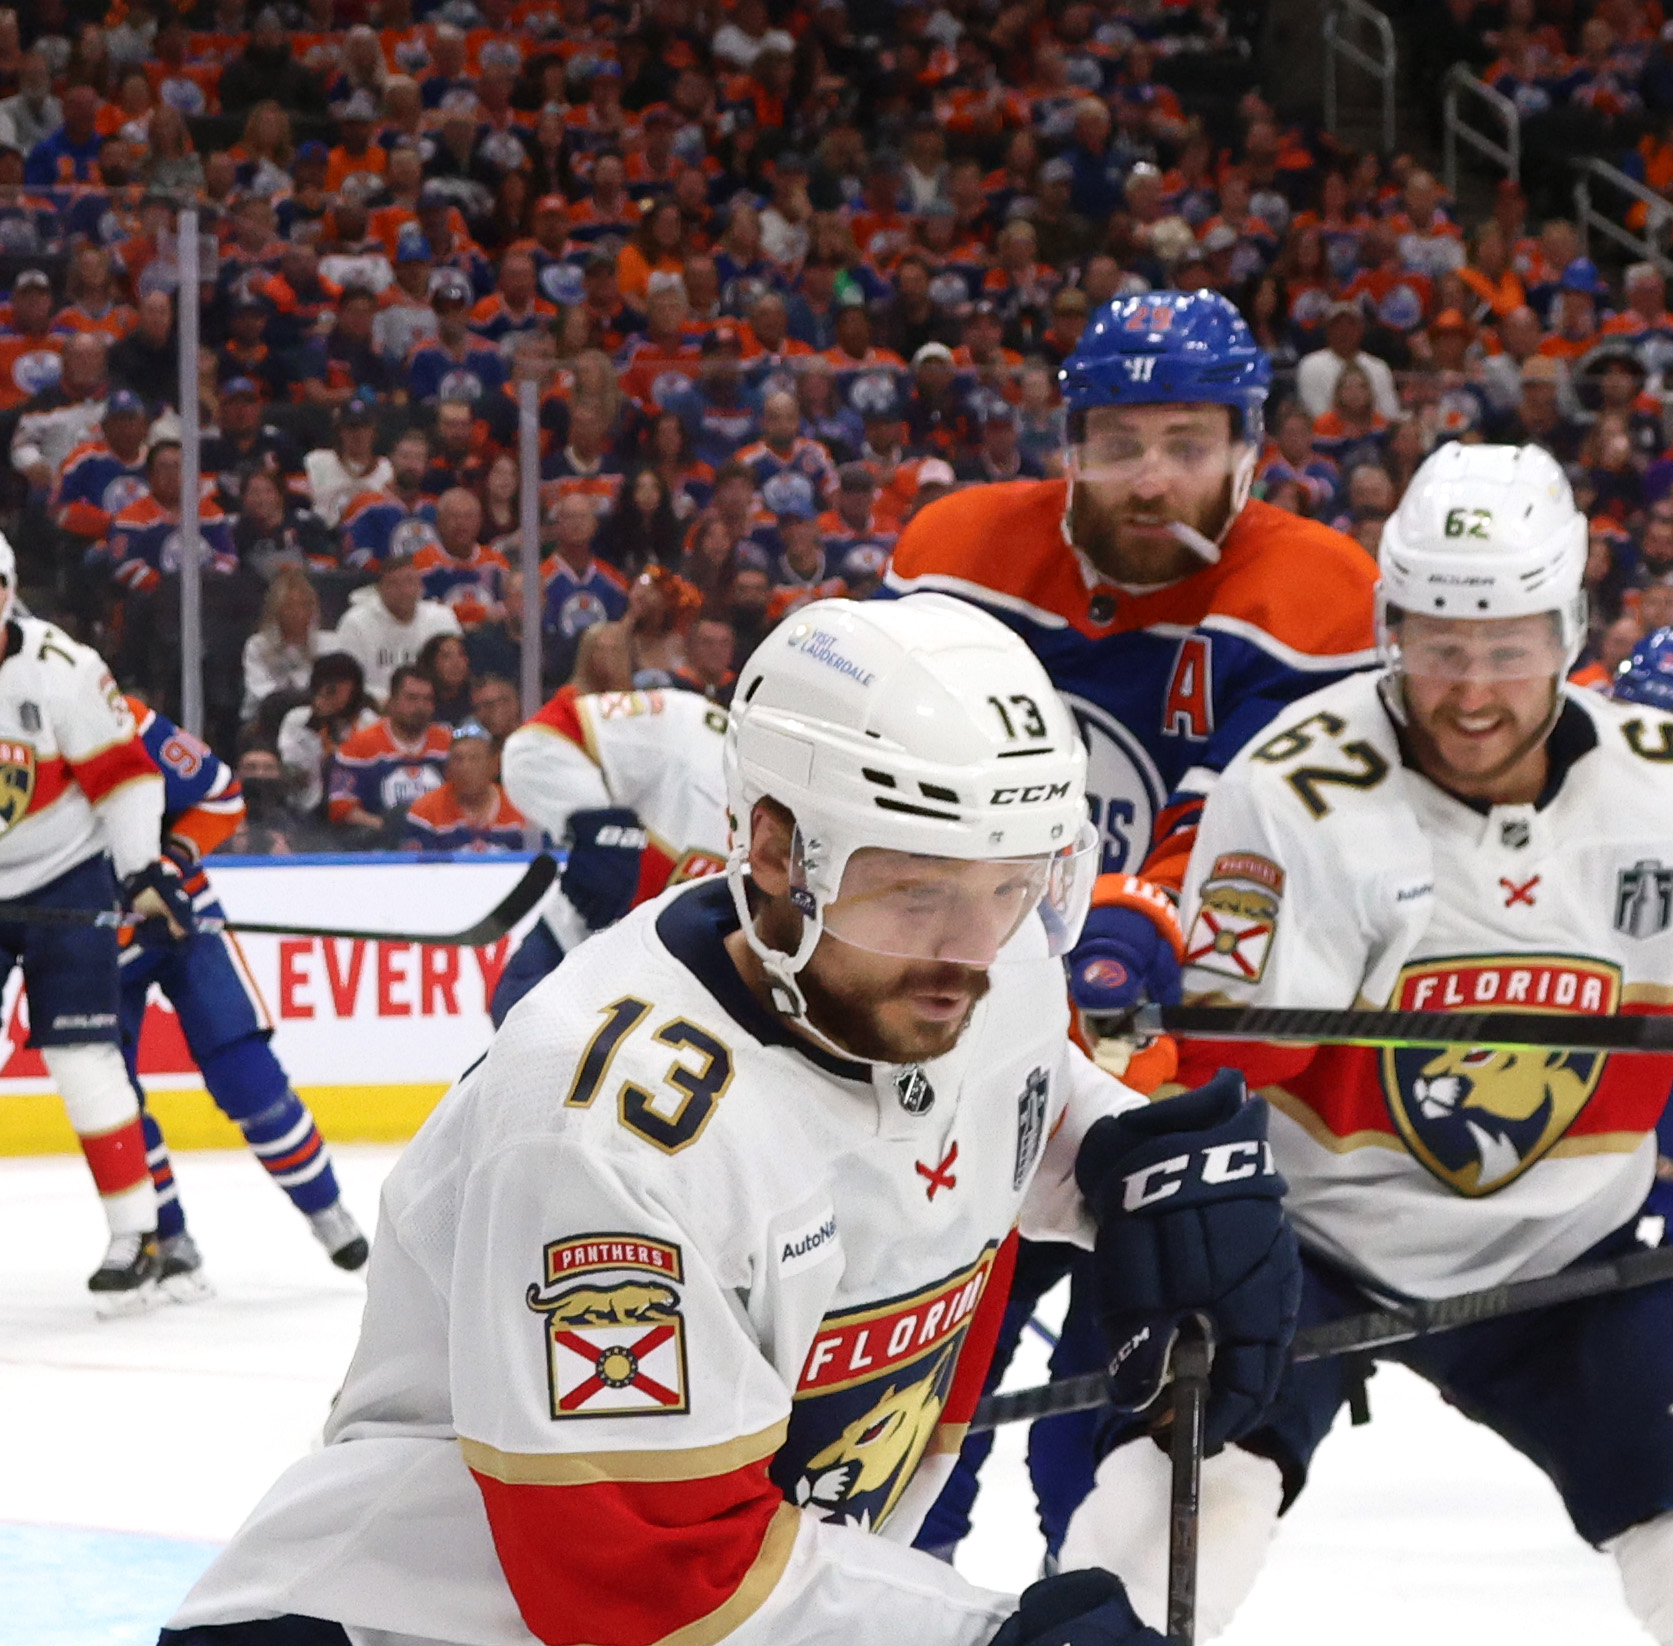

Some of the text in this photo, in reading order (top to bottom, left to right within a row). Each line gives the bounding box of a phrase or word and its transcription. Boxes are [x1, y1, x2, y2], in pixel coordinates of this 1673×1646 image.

[1126, 307, 1172, 330] 29
[1445, 508, 1491, 538] 62
[801, 640, 875, 687] LAUDERDALE
[1162, 635, 1214, 741] A
[987, 693, 1047, 739] 13
[1252, 710, 1388, 820] 62
[990, 780, 1071, 805] CCM
[1412, 970, 1604, 1011] FLORIDA
[565, 995, 735, 1154] 13
[562, 1245, 664, 1268] PANTHERS
